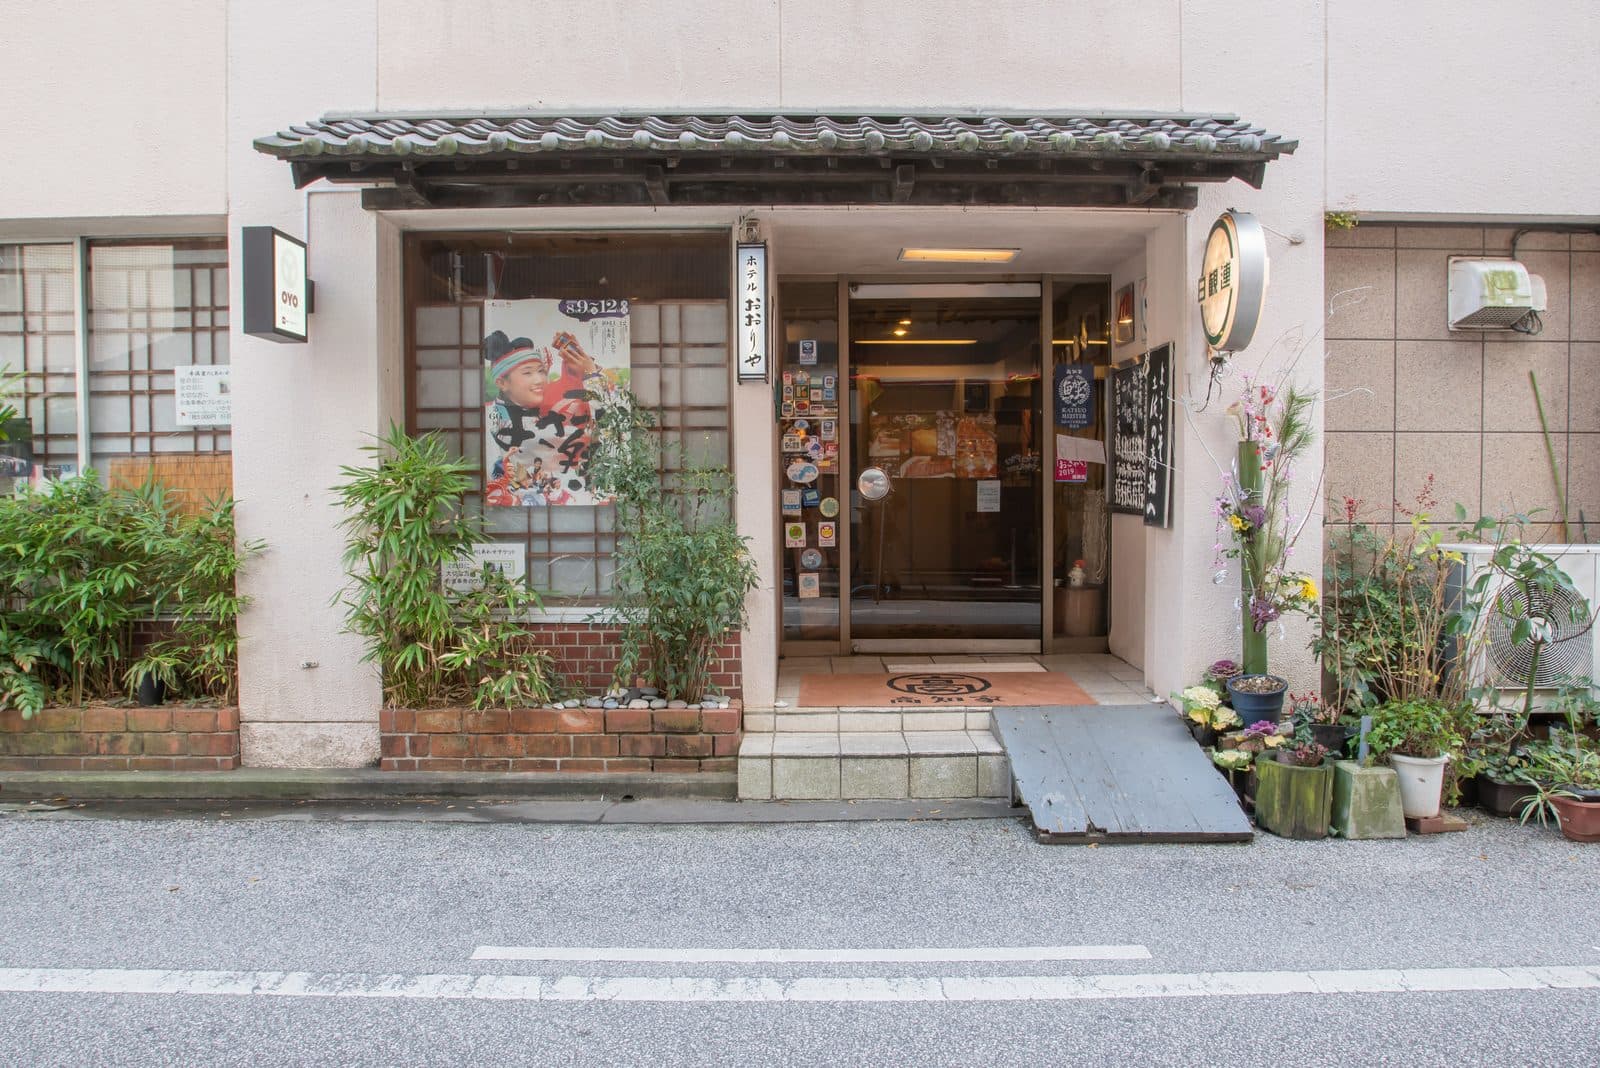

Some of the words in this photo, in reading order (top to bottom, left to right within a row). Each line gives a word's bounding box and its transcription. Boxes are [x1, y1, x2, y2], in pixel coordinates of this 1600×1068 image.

[281, 291, 299, 308] OYO
[745, 255, 761, 367] ホテルおおりや
[1058, 468, 1075, 476] 2019
